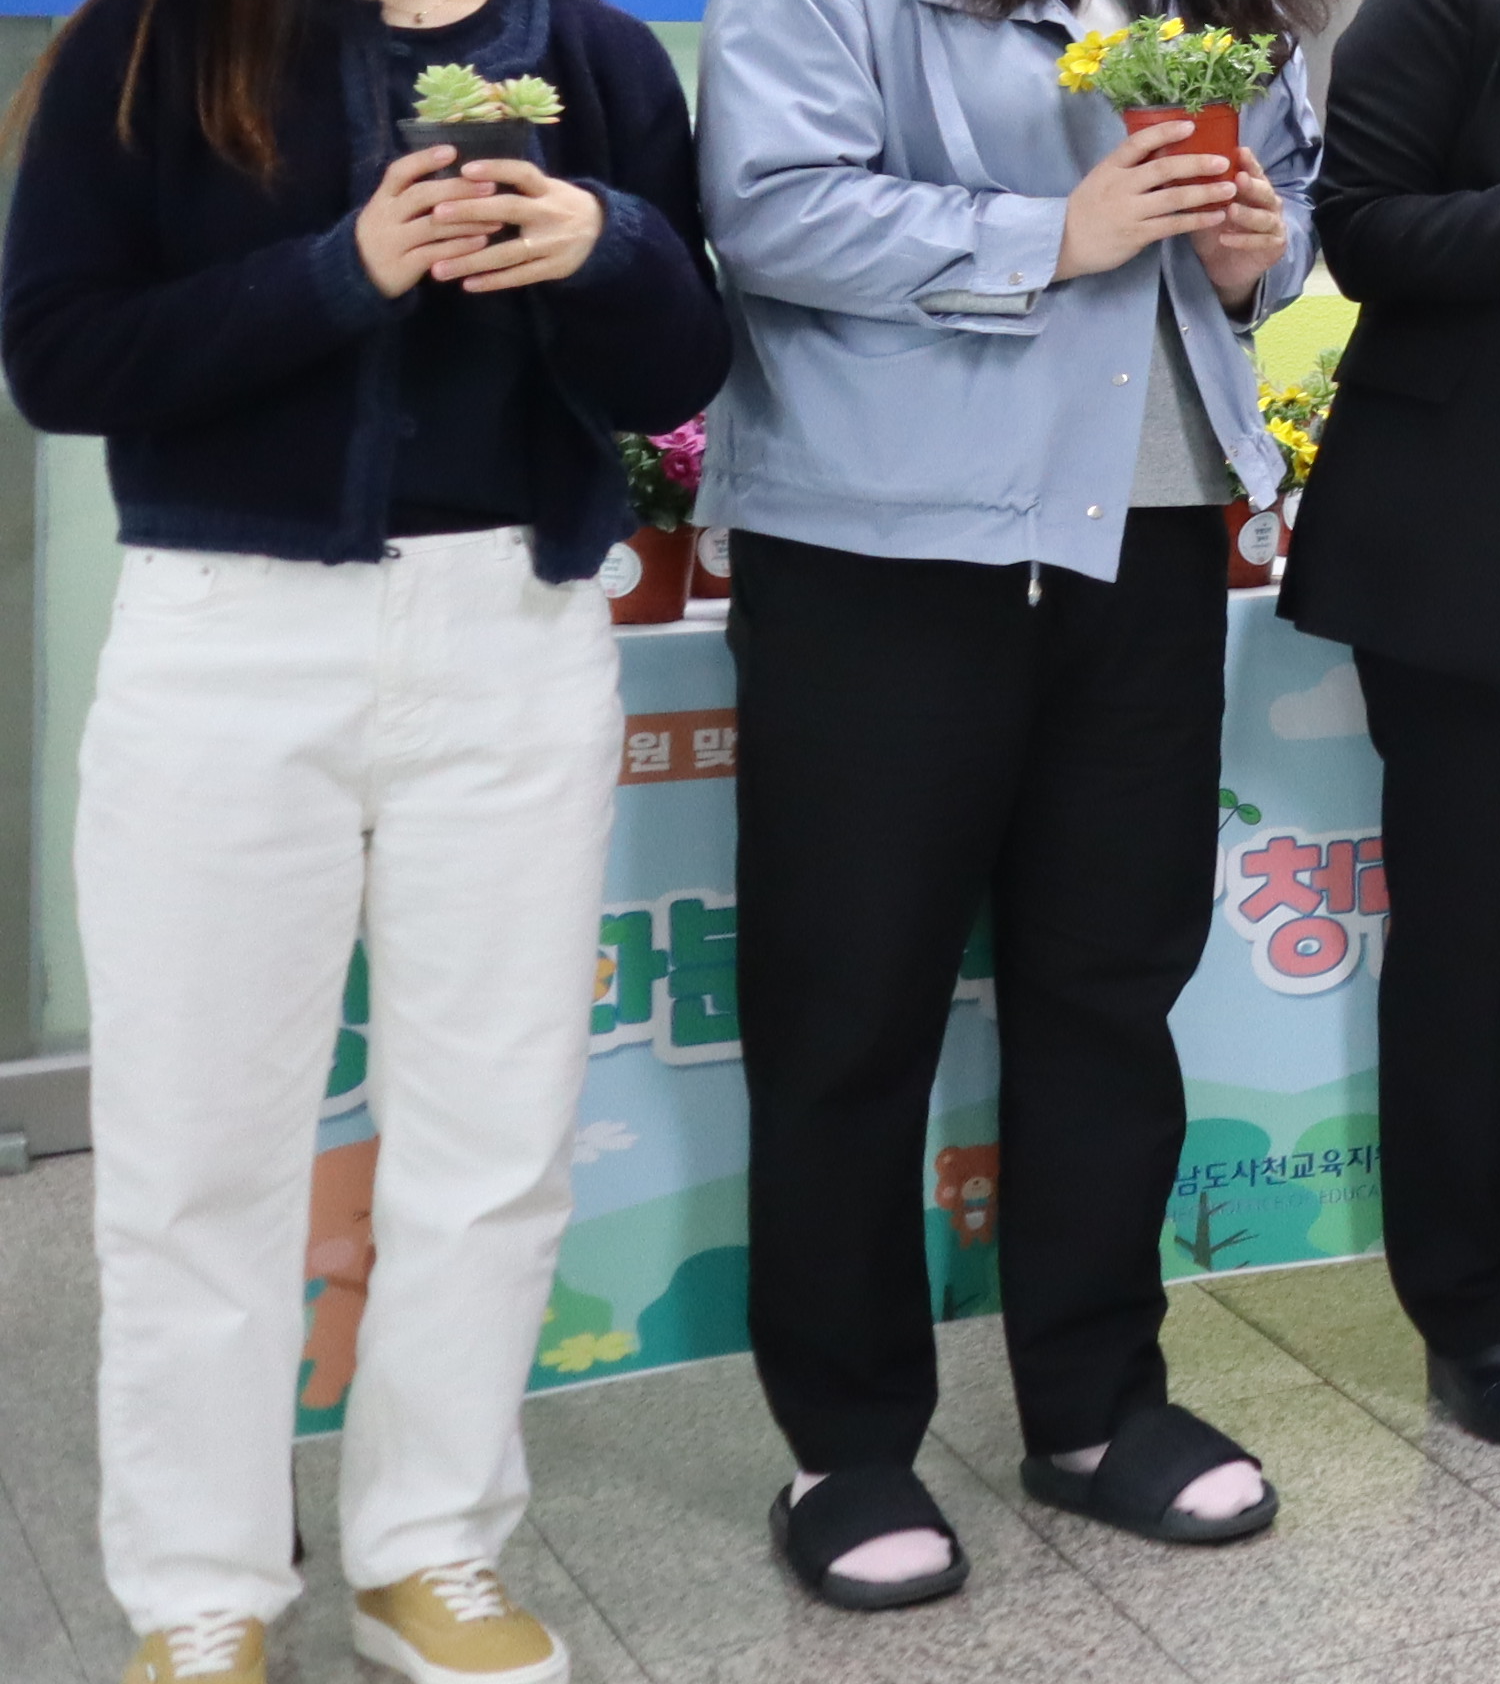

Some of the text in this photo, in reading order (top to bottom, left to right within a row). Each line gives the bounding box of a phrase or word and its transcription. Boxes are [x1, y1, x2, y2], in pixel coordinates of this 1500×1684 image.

[627, 731, 672, 774] 원
[1174, 1144, 1381, 1198] 남도사천교육지
[1319, 1184, 1380, 1205] EDUCA
